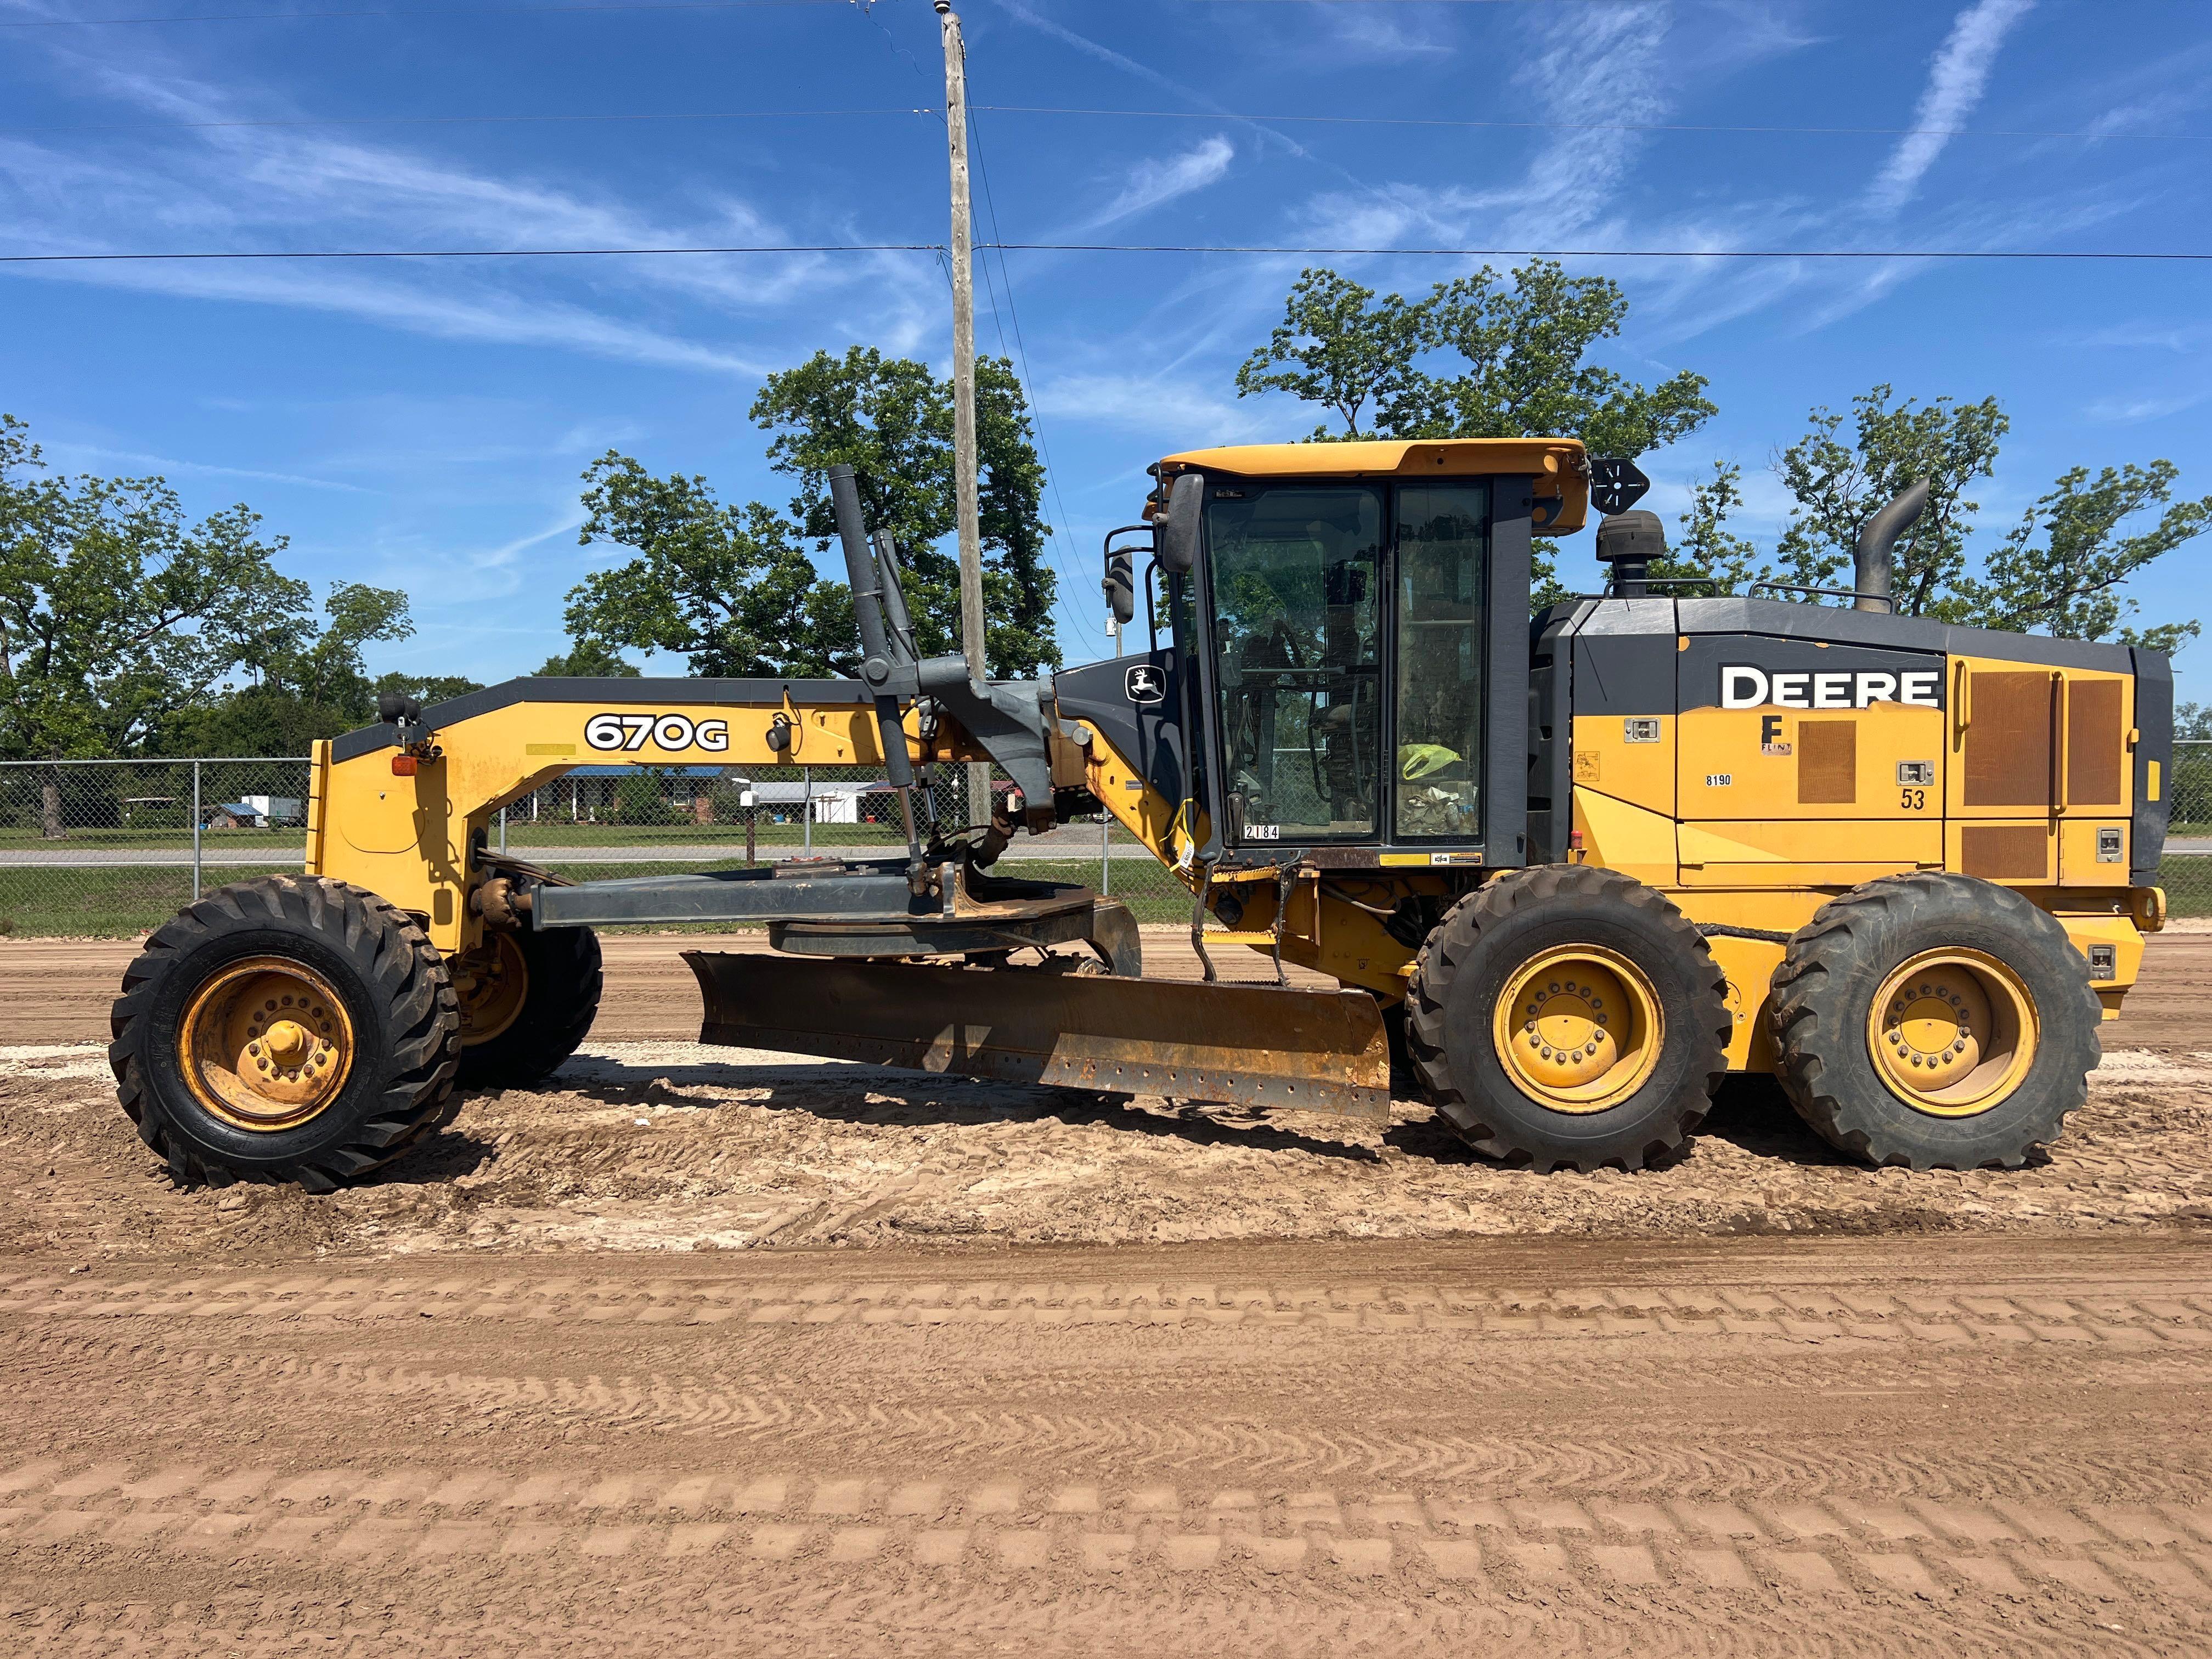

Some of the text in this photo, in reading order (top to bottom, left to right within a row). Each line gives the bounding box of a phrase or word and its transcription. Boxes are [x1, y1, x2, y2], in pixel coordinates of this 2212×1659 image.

[1722, 667, 1938, 709] DEERE
[584, 713, 729, 752] 670G
[1762, 715, 1782, 743] F
[1707, 775, 1730, 786] 8190
[1901, 788, 1925, 810] 53
[1246, 826, 1278, 838] 2184
